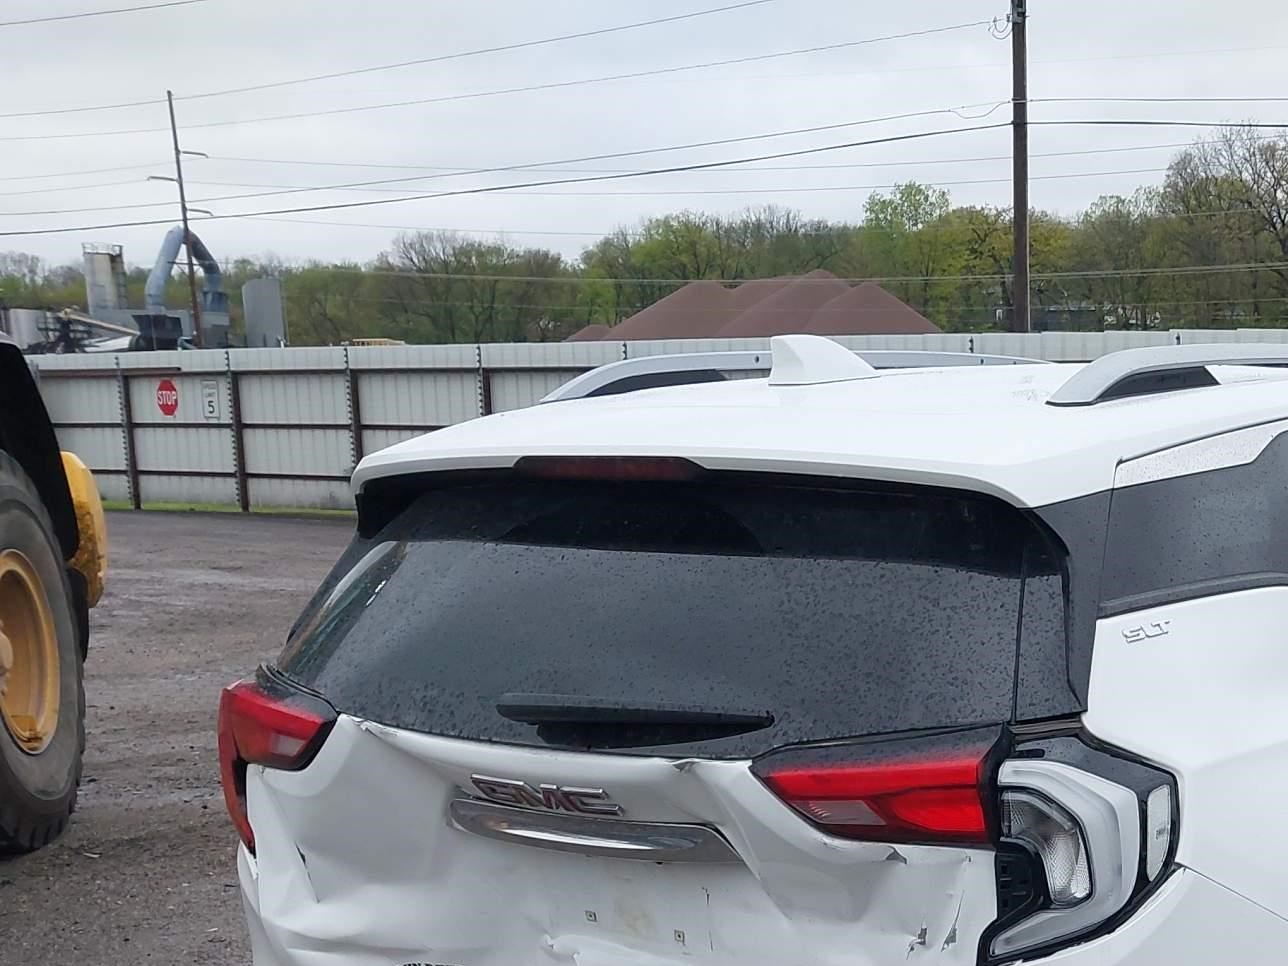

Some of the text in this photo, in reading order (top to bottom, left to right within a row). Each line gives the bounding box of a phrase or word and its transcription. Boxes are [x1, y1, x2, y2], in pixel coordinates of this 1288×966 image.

[157, 390, 177, 405] STOP
[207, 400, 215, 414] 5
[1121, 620, 1171, 644] SLT
[470, 773, 625, 817] GMC
